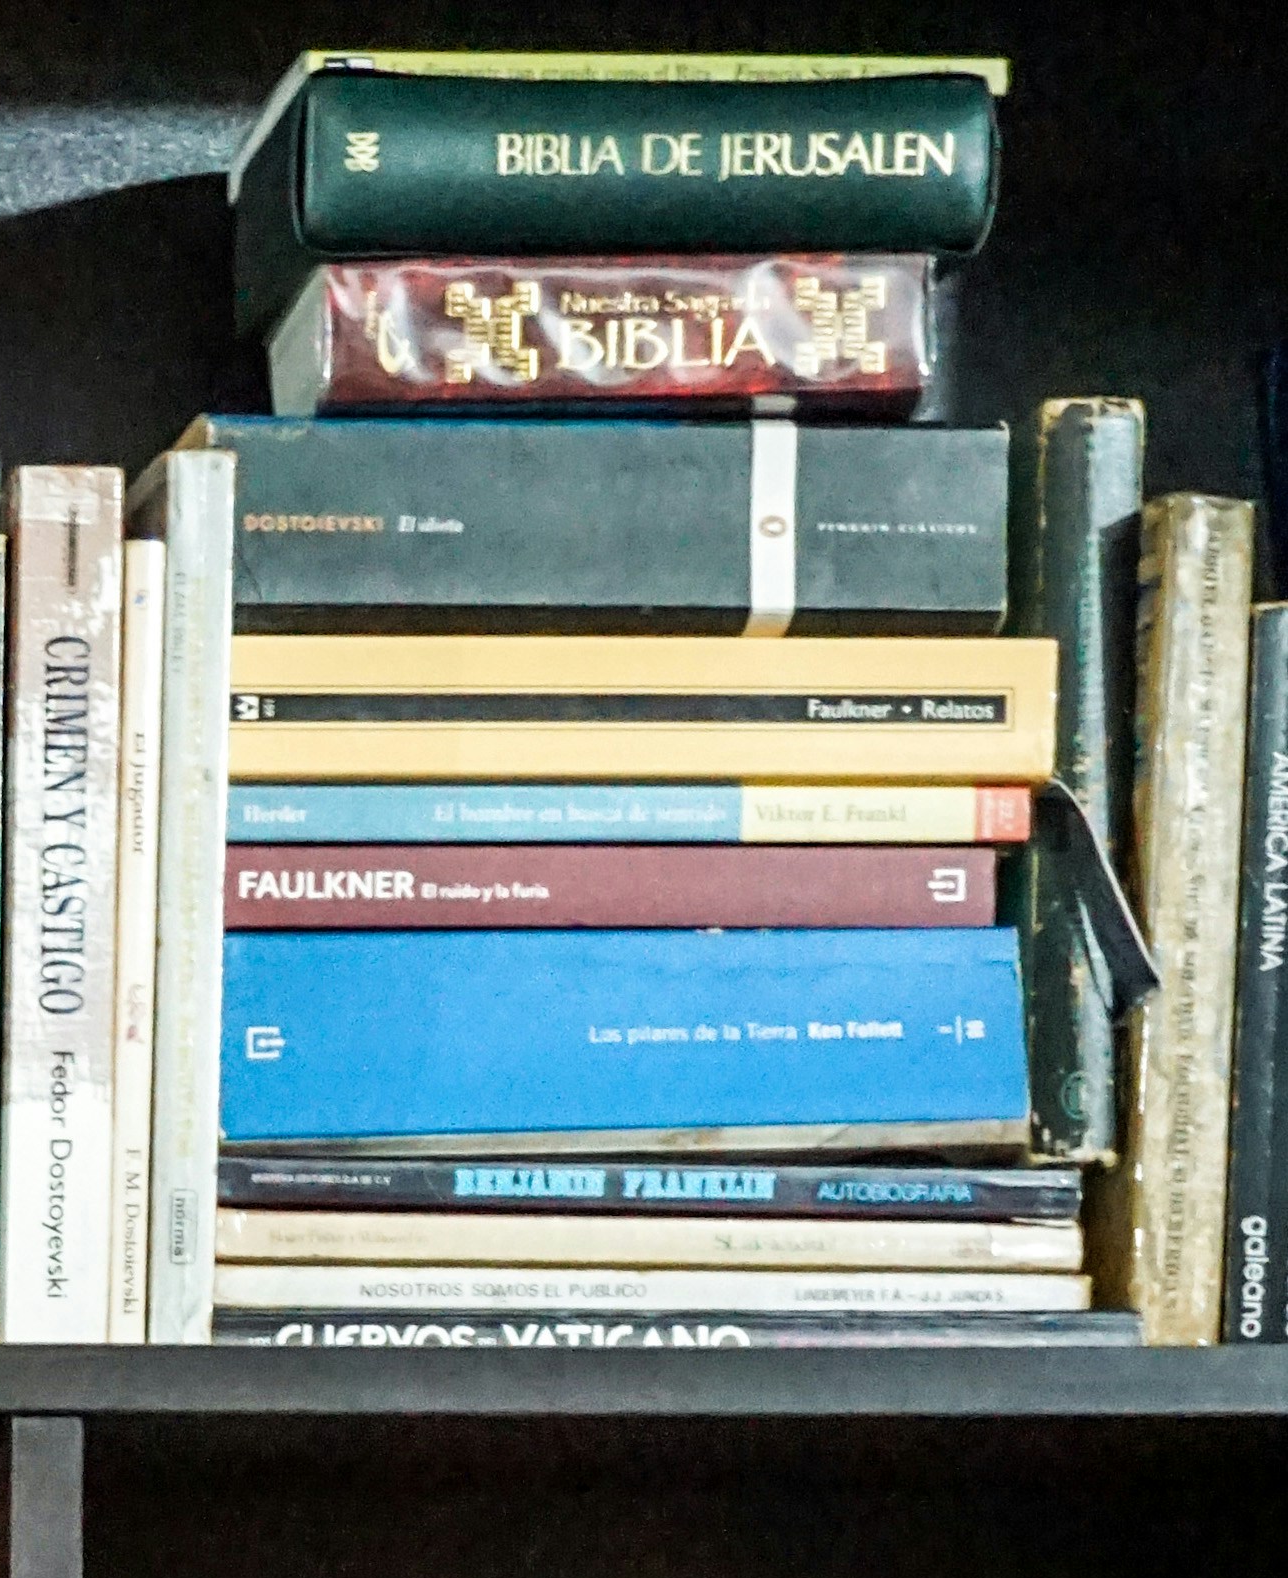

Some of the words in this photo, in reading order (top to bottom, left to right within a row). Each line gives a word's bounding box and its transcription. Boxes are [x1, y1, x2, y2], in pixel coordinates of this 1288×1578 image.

[495, 132, 625, 177] BIBLIA
[640, 132, 703, 177] DE
[718, 131, 958, 178] JERUSALEN
[555, 318, 778, 370] BIBLIA
[43, 635, 92, 793] CRIMEN
[801, 695, 894, 722] Faulkner
[916, 695, 999, 720] Relatos
[42, 807, 86, 823] Y
[232, 866, 418, 904] FAULKNER
[38, 843, 85, 1015] CASTIGO
[50, 1049, 76, 1124] Fedor
[41, 1138, 73, 1299] Dostoyevski
[1235, 1209, 1268, 1342] galeano
